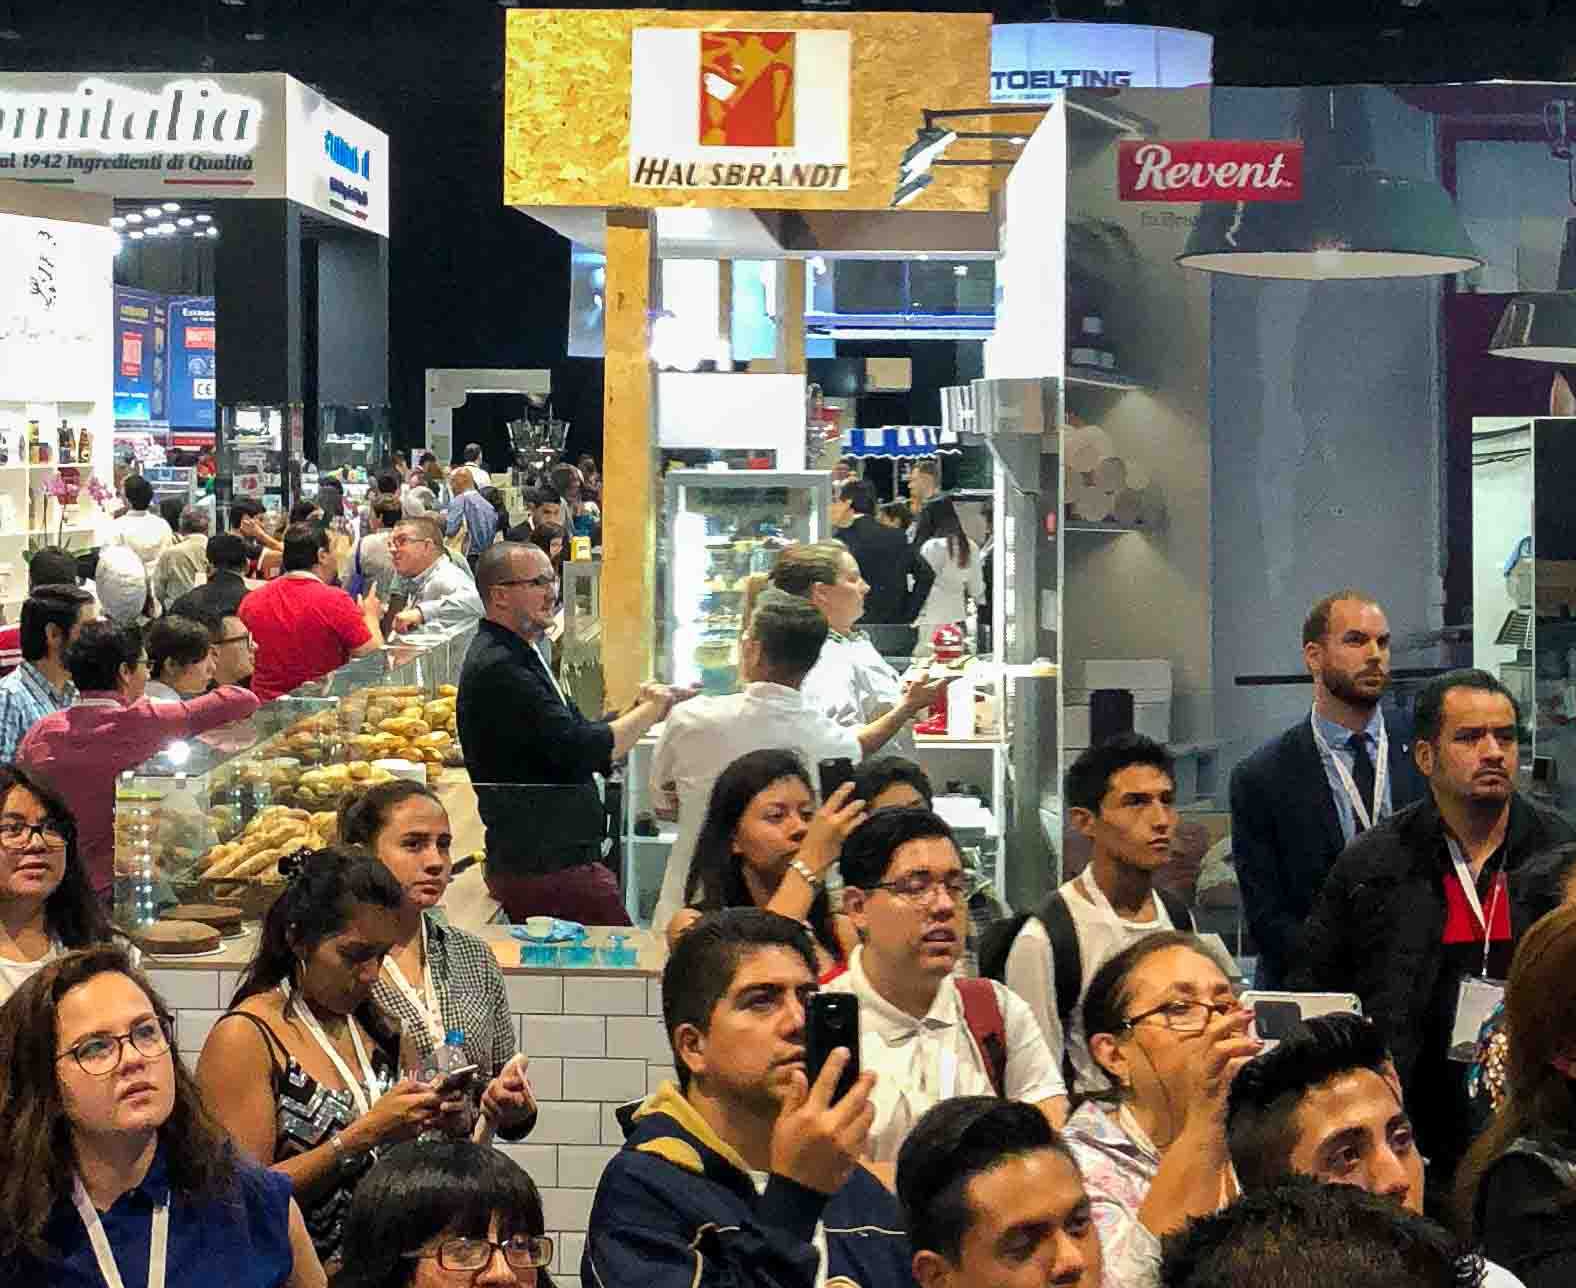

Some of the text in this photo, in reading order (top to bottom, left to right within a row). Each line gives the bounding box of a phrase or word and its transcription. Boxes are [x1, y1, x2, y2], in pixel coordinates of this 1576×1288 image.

[23, 153, 63, 169] 1942
[66, 153, 163, 175] Ingredienti
[166, 153, 184, 170] di
[190, 153, 254, 173] Qualità
[1134, 144, 1286, 191] Revent
